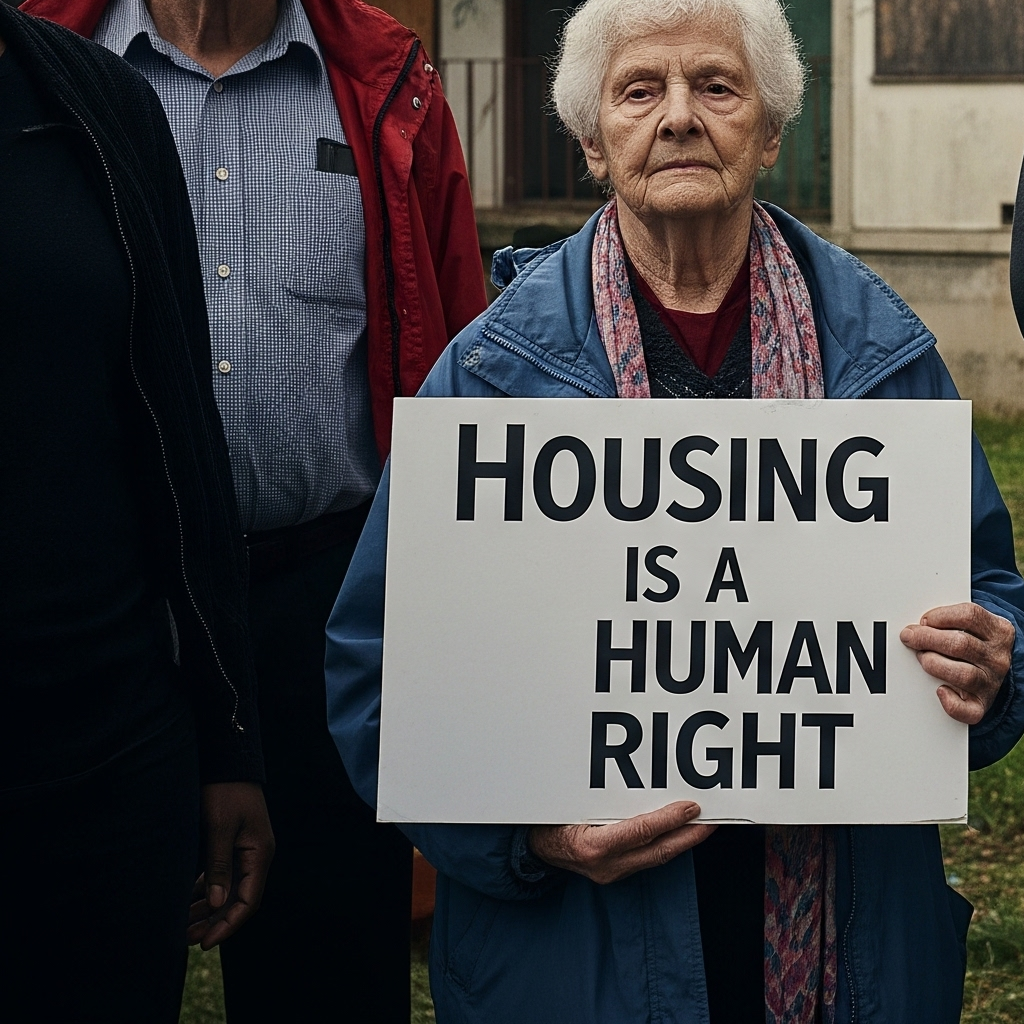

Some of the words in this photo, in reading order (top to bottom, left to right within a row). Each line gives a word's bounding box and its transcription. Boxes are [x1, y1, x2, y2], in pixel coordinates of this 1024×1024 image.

[455, 423, 890, 523] HOUSING
[624, 545, 681, 603] IS
[704, 546, 750, 603] A
[594, 619, 888, 695] HUMAN
[588, 709, 855, 791] RIGHT
